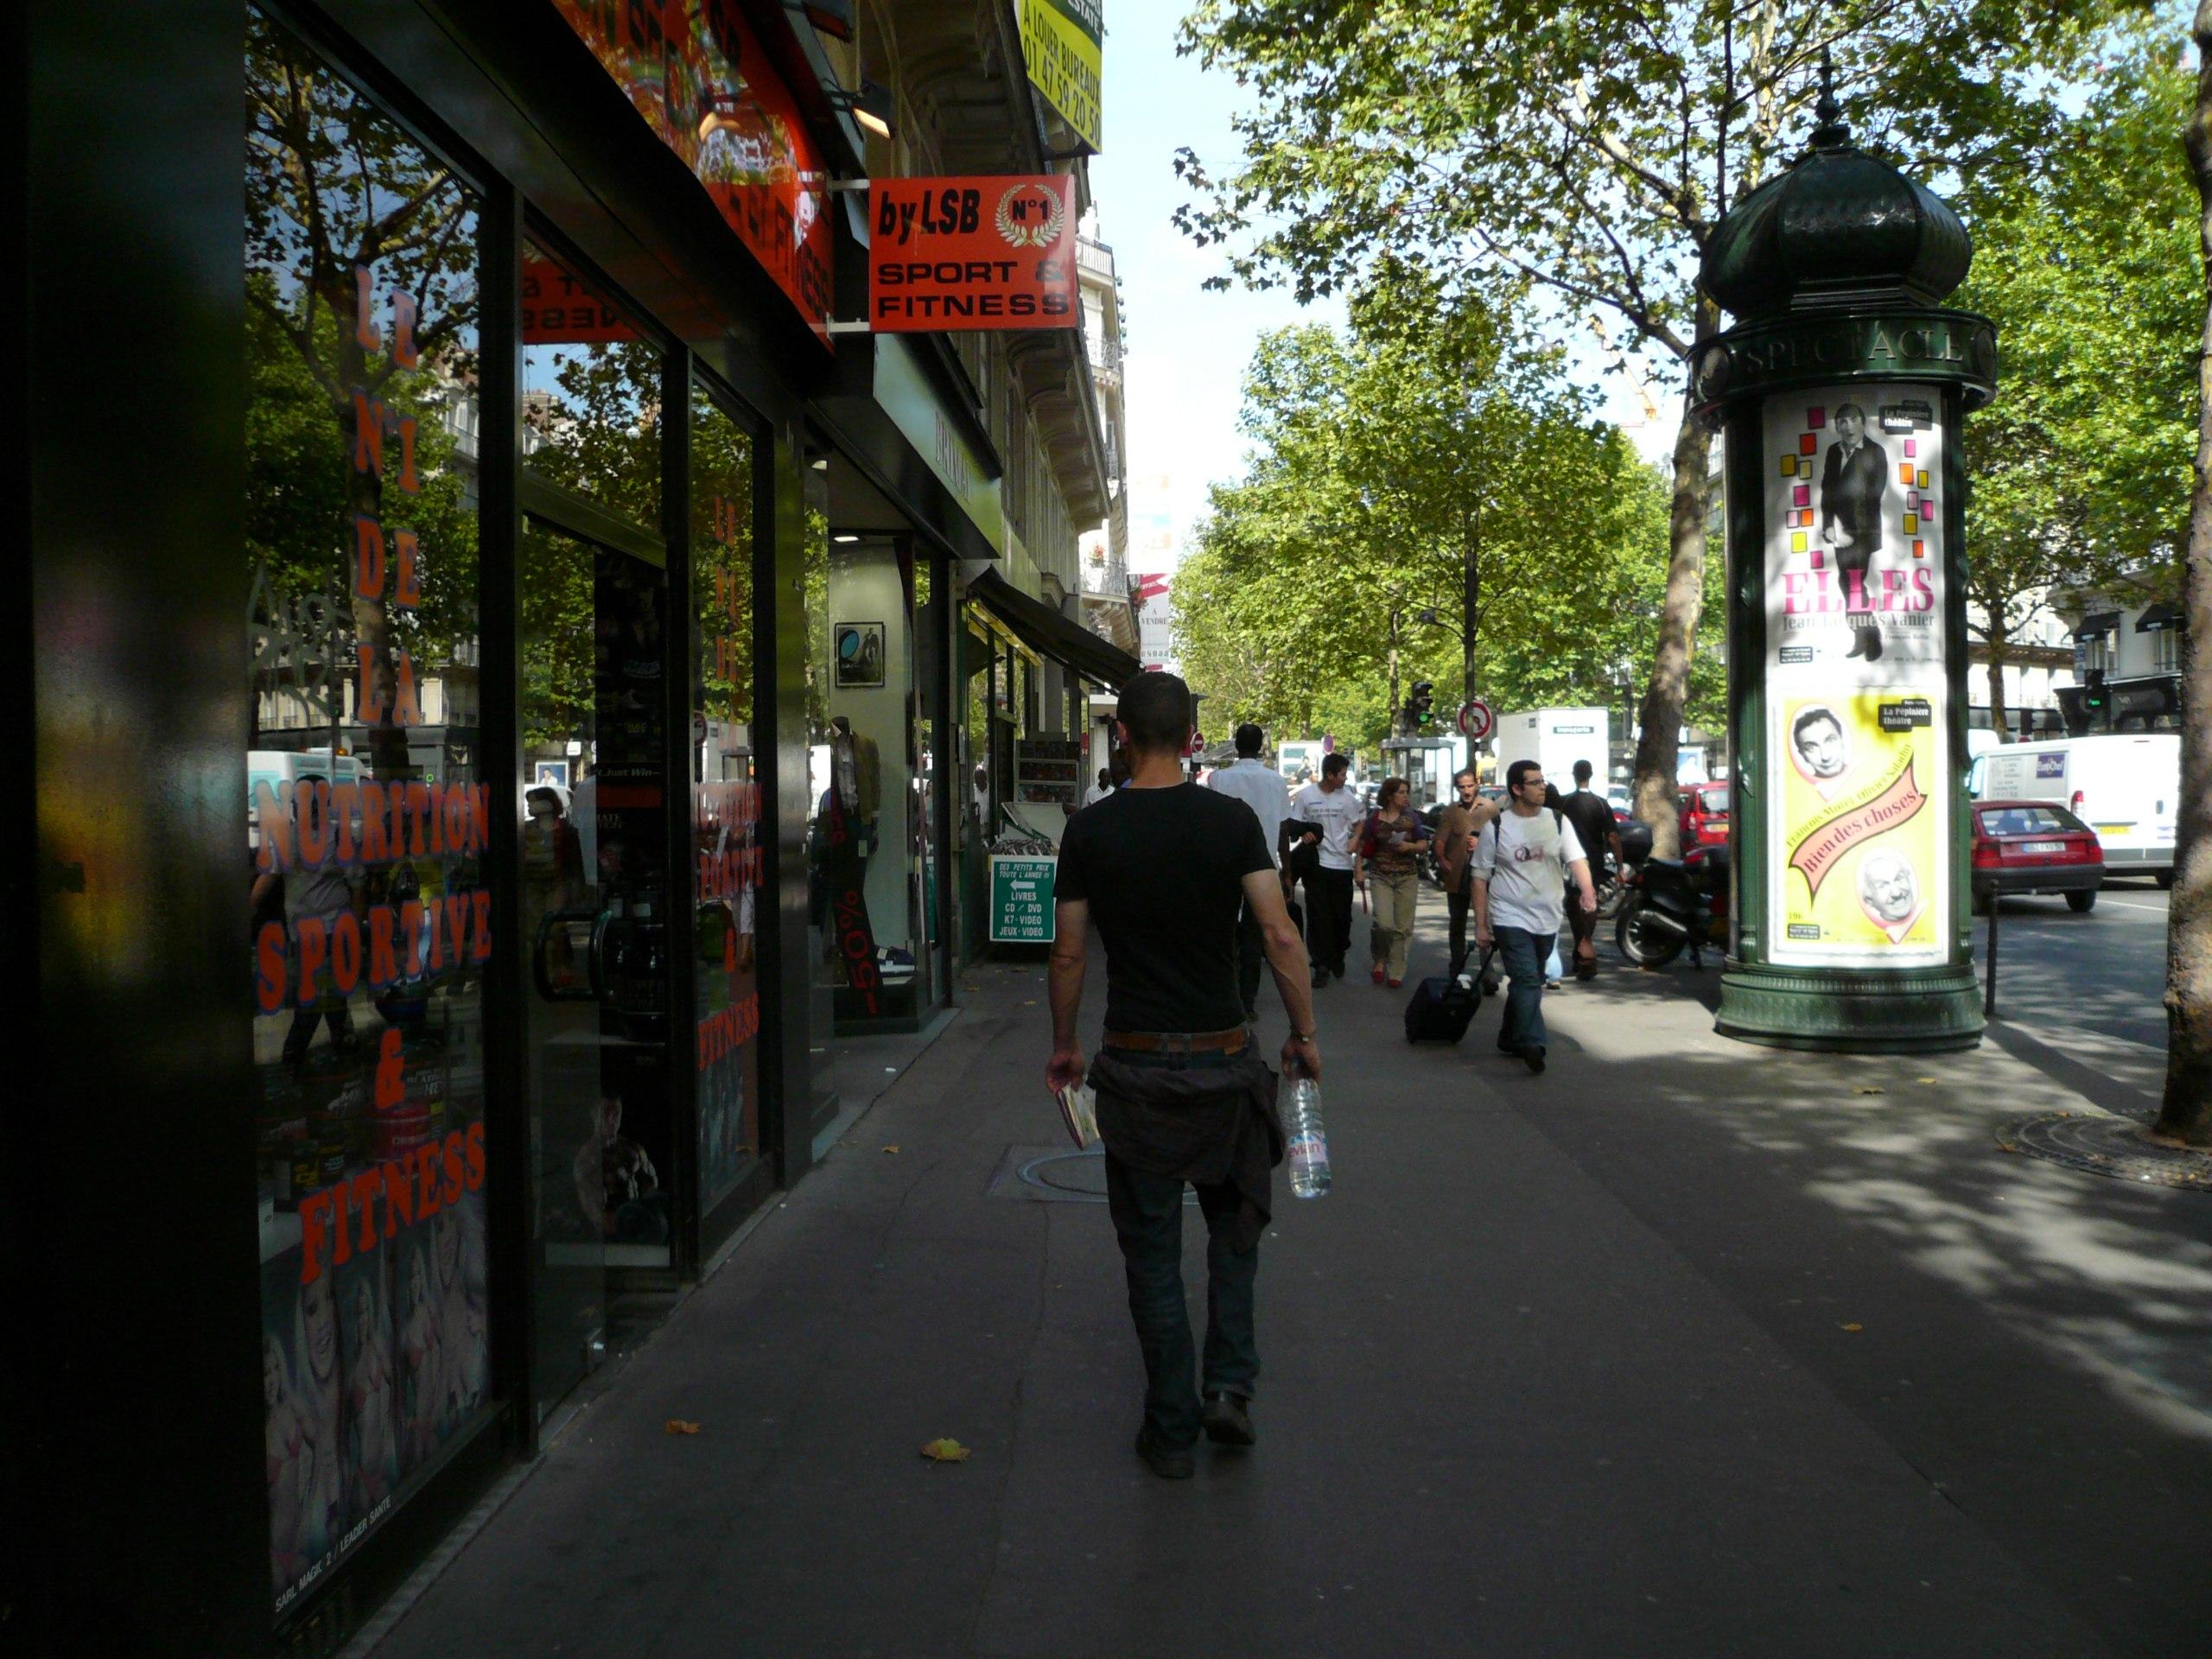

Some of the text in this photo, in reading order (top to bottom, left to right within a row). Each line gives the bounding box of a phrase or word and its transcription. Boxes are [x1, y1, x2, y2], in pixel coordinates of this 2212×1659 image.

[1023, 1, 1031, 30] A
[1033, 5, 1059, 64] LOUER
[1061, 41, 1101, 110] BUREAUX
[1024, 35, 1101, 147] 01 47 59 20 50
[878, 189, 981, 245] by LSB
[878, 260, 1065, 285] SPORT &
[878, 294, 1070, 318] FITNESS
[1782, 567, 1935, 614] ELLES
[1888, 613, 1935, 627] Vanier
[256, 779, 492, 874] NUTRITION
[1803, 790, 1917, 874] Bien des choses
[1005, 903, 1015, 912] CD
[1027, 904, 1042, 913] DVD
[1011, 891, 1037, 901] LIVRES
[255, 889, 493, 1018] SPORTIVE
[374, 1027, 407, 1111] &
[298, 1121, 487, 1286] FITNESS
